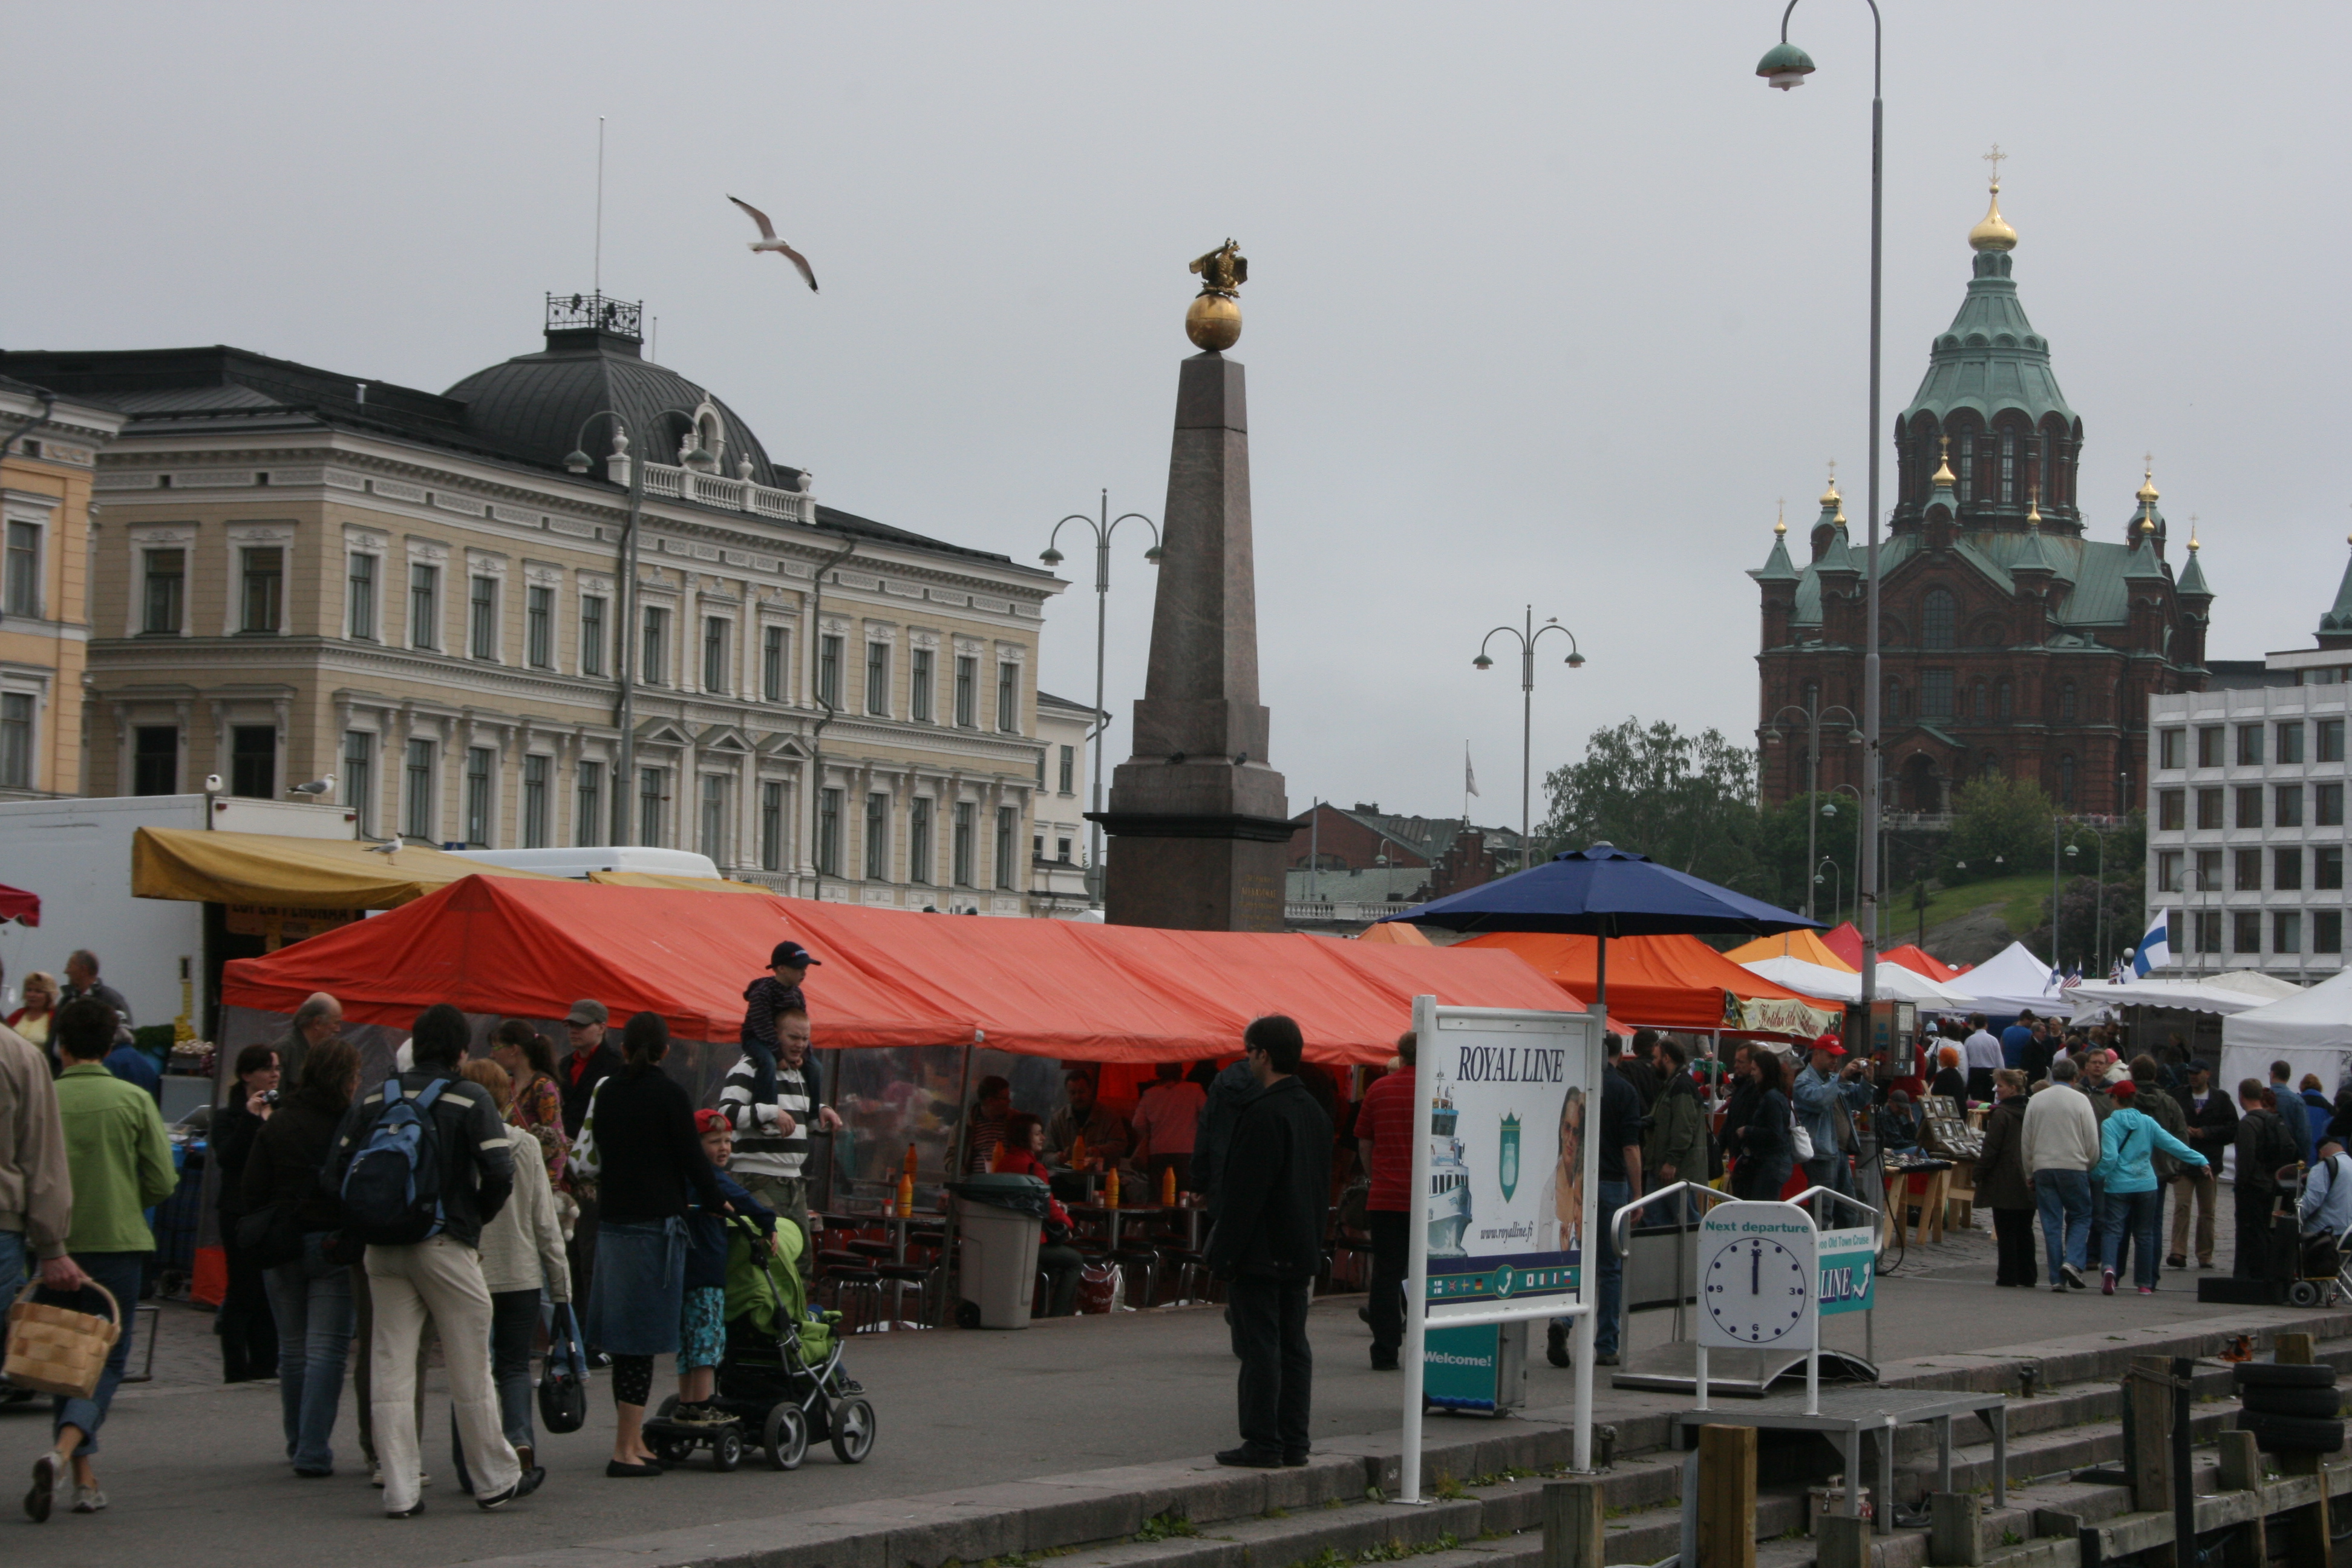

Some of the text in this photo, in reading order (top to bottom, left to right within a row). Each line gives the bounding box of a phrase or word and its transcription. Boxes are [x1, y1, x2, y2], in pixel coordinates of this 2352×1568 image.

[1457, 1046, 1564, 1082] ROYAL LINE
[1480, 1220, 1534, 1244] www.royalline.fi
[1705, 1221, 1809, 1233] Next departure
[1828, 1236, 1837, 1248] Old
[1838, 1236, 1852, 1247] Town
[1853, 1234, 1869, 1246] Cruise
[1818, 1267, 1852, 1302] LINE
[1423, 1350, 1491, 1367] Welcome!
